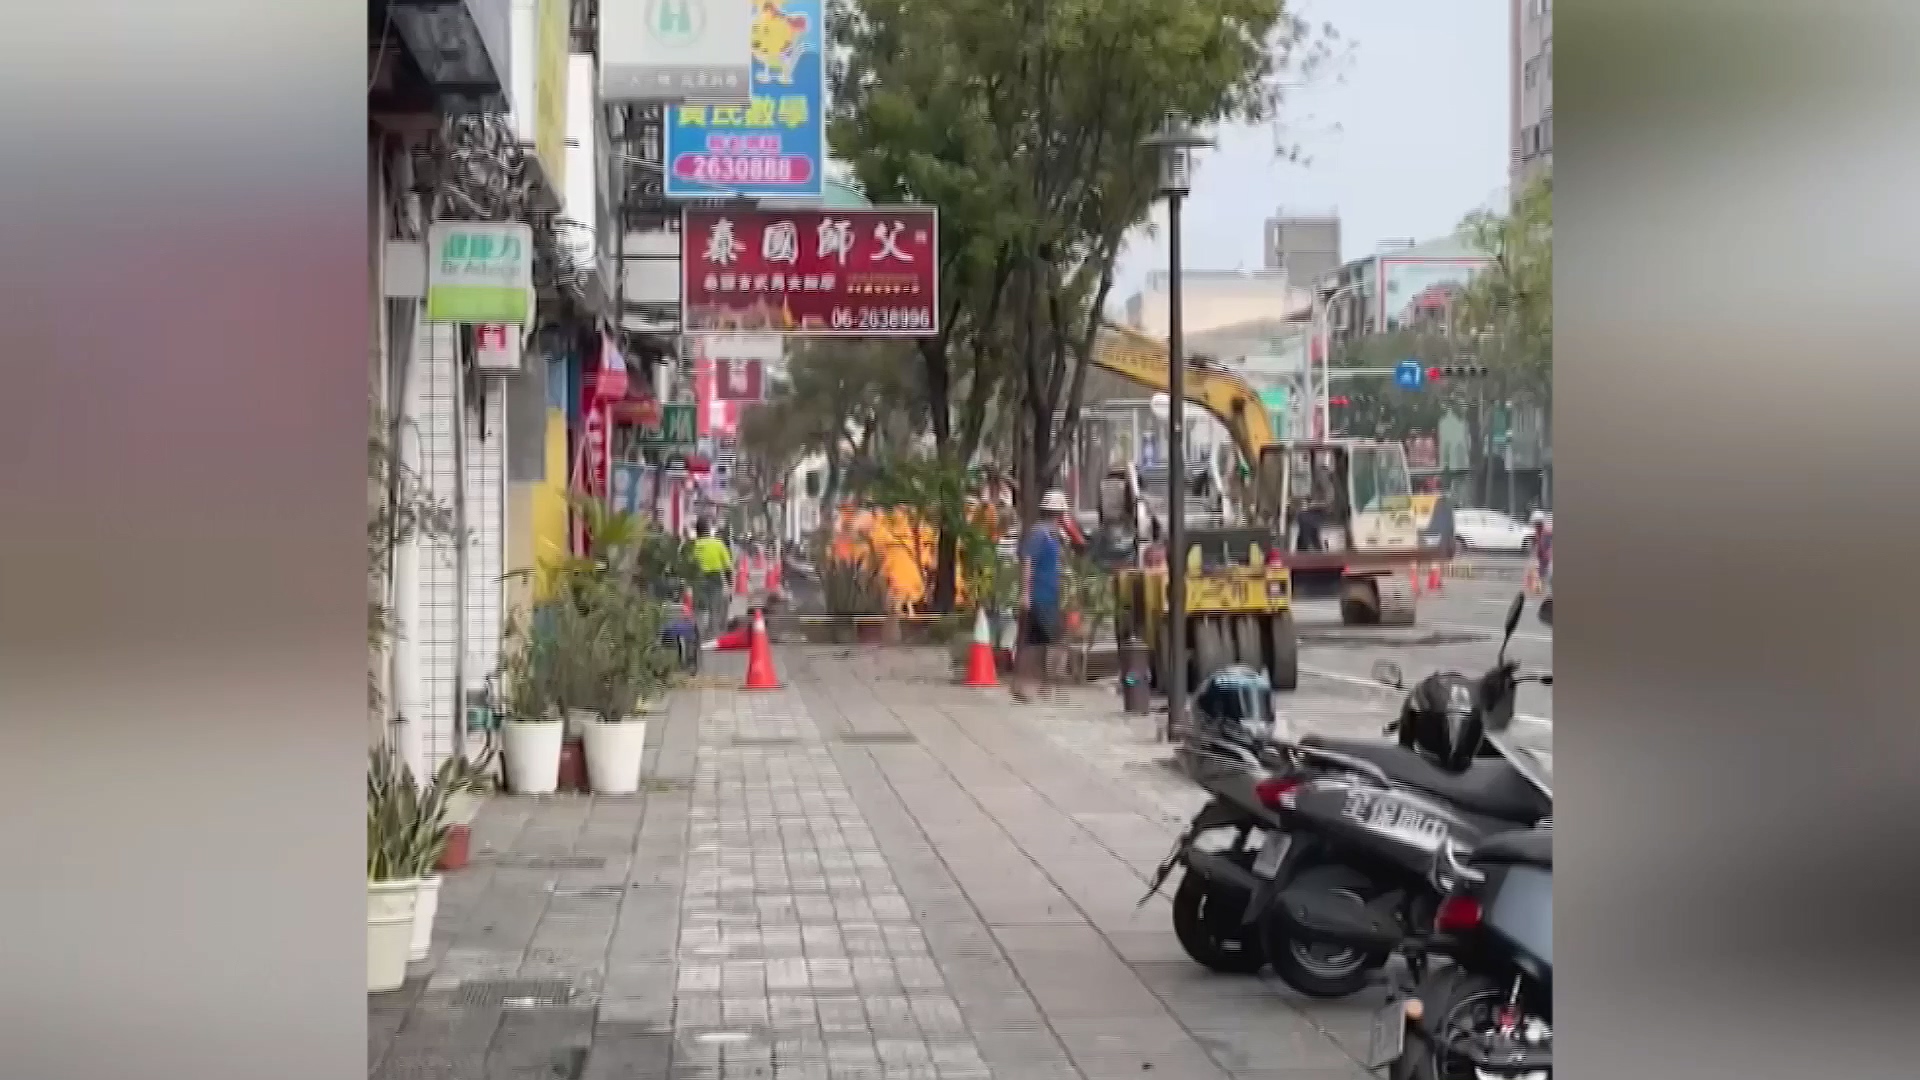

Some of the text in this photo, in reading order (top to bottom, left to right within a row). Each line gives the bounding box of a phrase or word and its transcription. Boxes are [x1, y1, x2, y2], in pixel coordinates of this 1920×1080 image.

[701, 217, 915, 266] 泰國師父
[831, 305, 930, 329] 06-2638996
